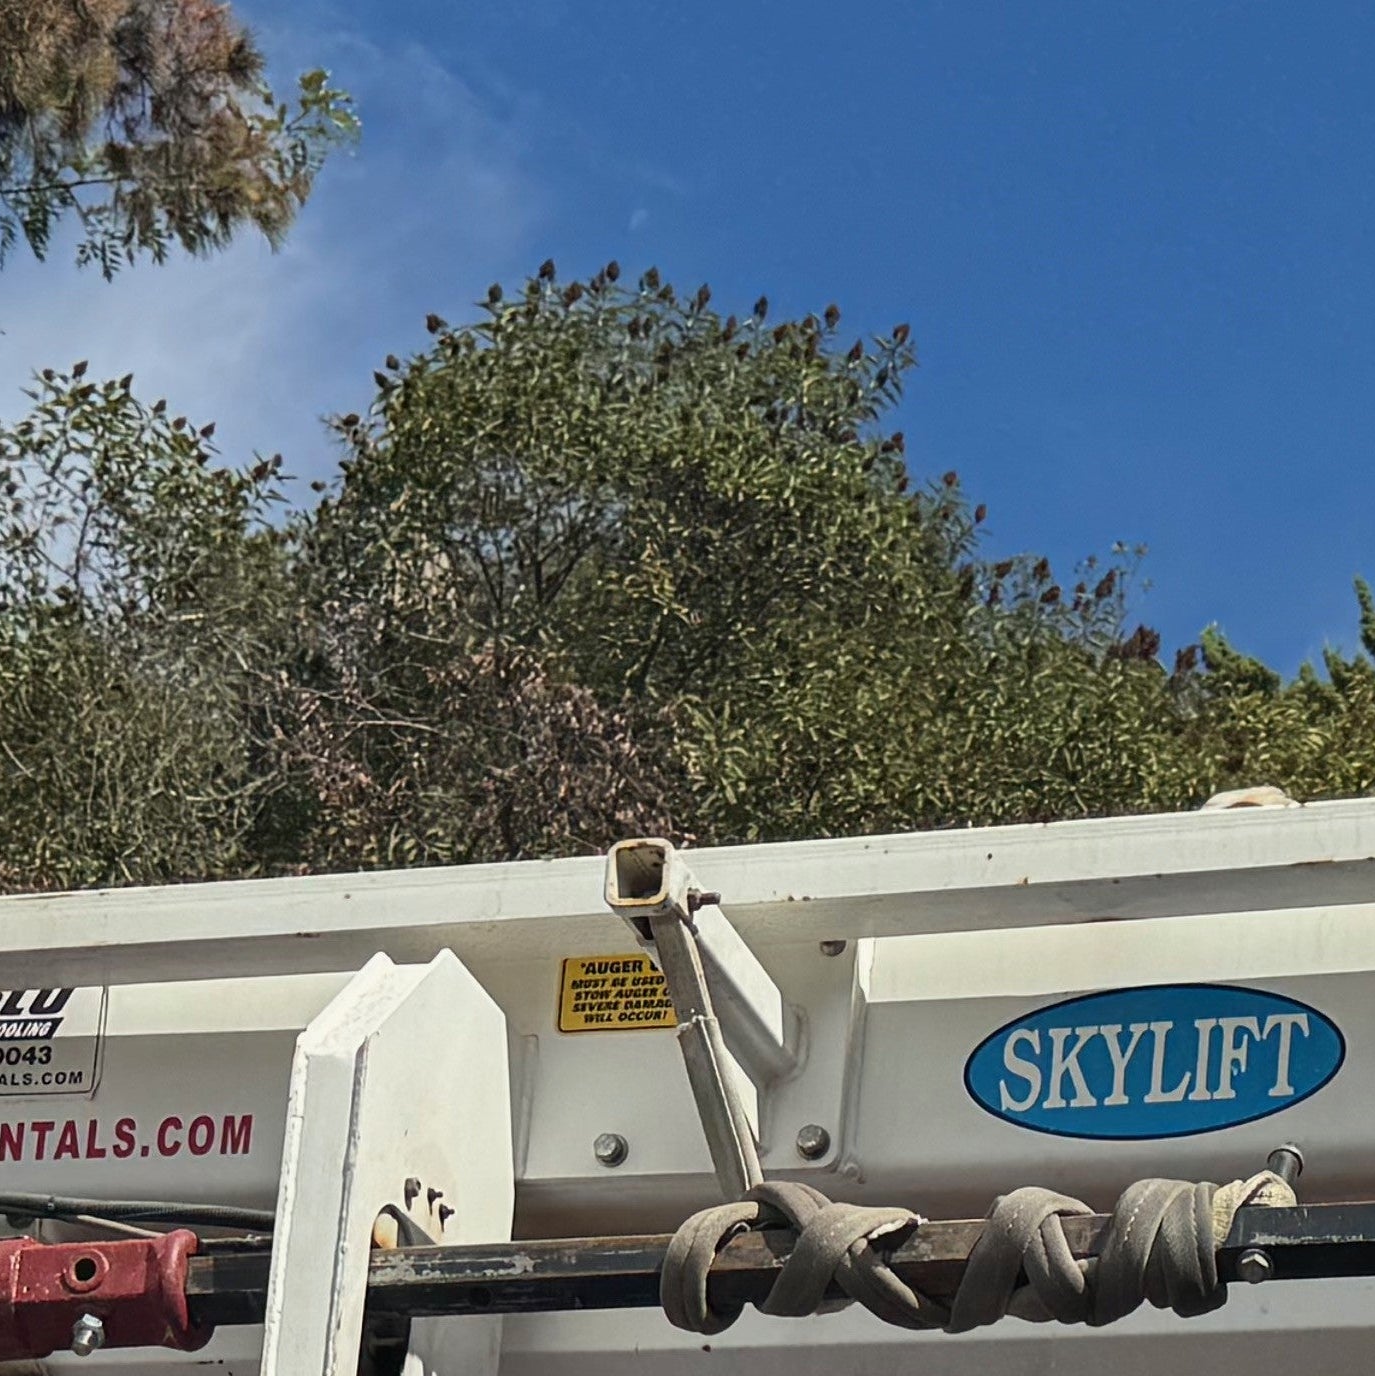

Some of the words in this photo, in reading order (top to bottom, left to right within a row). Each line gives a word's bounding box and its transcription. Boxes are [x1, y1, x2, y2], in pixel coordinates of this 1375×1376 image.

[571, 978, 608, 990] MUST
[610, 977, 629, 988] BE
[631, 975, 665, 987] USED
[574, 990, 612, 1001] STOW
[612, 988, 659, 1000] AUGER
[572, 1001, 621, 1013] SEVERE
[624, 998, 673, 1010] DAMAG
[583, 1012, 613, 1024] WILL
[617, 1010, 668, 1022] OCCUR!
[998, 1012, 1310, 1113] SKYLIFT
